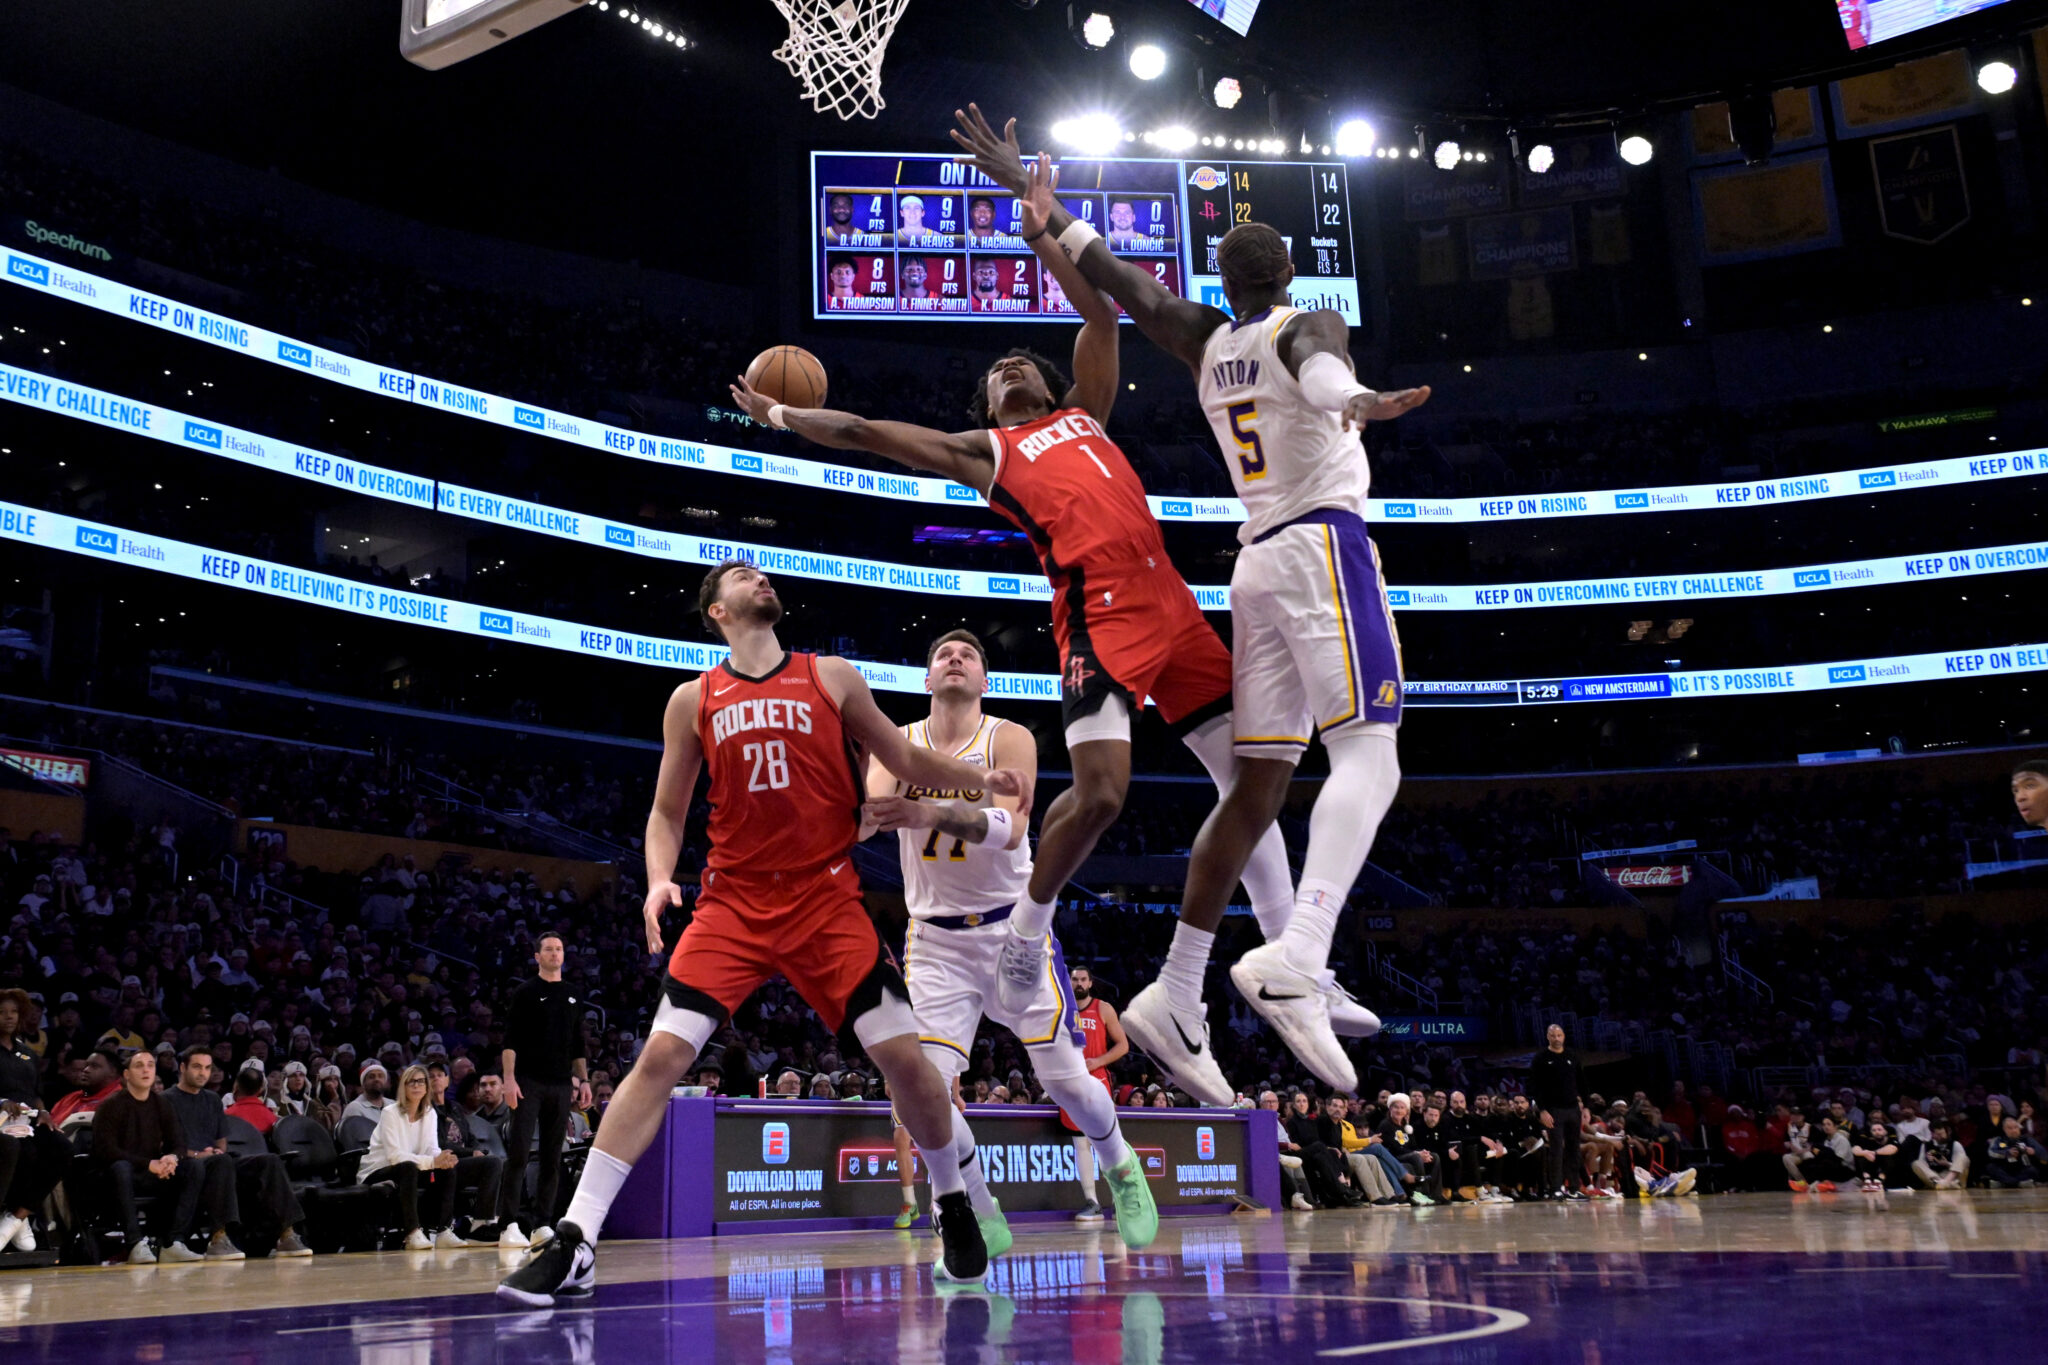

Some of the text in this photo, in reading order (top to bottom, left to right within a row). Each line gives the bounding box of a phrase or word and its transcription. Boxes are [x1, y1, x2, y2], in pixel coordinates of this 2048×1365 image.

[939, 162, 965, 185] ON
[1235, 172, 1249, 192] 14
[1321, 173, 1338, 193] 14
[870, 197, 882, 216] 4
[941, 197, 953, 219] 9
[1081, 200, 1092, 221] 0
[1151, 201, 1162, 222] 0
[1235, 203, 1252, 223] 22
[1323, 204, 1341, 225] 22
[869, 219, 885, 230] PTS
[940, 220, 956, 232] PTS
[1150, 224, 1165, 235] PTS
[25, 220, 108, 261] Spectrum
[840, 234, 882, 247] D. AYTON
[910, 236, 955, 248] A. REAVES
[970, 237, 979, 249] R.
[1121, 239, 1129, 251] L.
[1311, 237, 1338, 247] Rockets
[1317, 249, 1329, 261] TOL
[1333, 250, 1338, 261] 7
[872, 258, 884, 279] 8
[943, 259, 955, 280] 0
[1014, 260, 1026, 282] 2
[1155, 263, 1166, 283] 2
[1317, 262, 1331, 274] FLS
[1335, 263, 1340, 274] 2
[12, 260, 97, 298] UCLA Health
[870, 282, 887, 293] PTS
[941, 283, 958, 294] PTS
[1013, 284, 1029, 295] PTS
[830, 297, 895, 310] A. THOMPSON
[901, 298, 967, 311] D. FINNEY-SMITH
[981, 299, 1030, 312] K. DURANT
[129, 294, 249, 348] KEEP ON RISING
[282, 346, 351, 377] UCLA Health
[1213, 360, 1259, 392] AYTON
[379, 372, 488, 415] KEEP ON RISING
[56, 387, 151, 430] CHALLENGE
[518, 412, 580, 436] UCLA Health
[189, 427, 265, 458] UCLA Health
[605, 430, 705, 464] KEEP ON RISING
[1226, 399, 1267, 482] 5
[735, 457, 798, 477] UCLA Health
[1079, 444, 1112, 478] 1
[1969, 458, 2008, 477] KEEP
[2012, 455, 2034, 471] ON
[824, 469, 919, 496] KEEP ON RISING
[1863, 469, 1939, 485] UCLA Health
[295, 452, 580, 535] KEEP ON OVERCOMING EVERY CHALLENGE
[949, 488, 973, 498] UCLA
[1619, 493, 1688, 506] UCLA Health
[1716, 478, 1830, 504] KEEP ON RISING
[1166, 504, 1230, 515] UCLA Health
[1388, 506, 1453, 516] UCLA Health
[1480, 496, 1587, 517] KEEP ON RISING
[81, 532, 165, 561] UCLA Health
[609, 529, 671, 551] UCLA Health
[699, 543, 960, 590] KEEP ON OVERCOMING EVERY CHALLENGE
[1799, 568, 1874, 584] UCLA Health
[1905, 558, 1943, 577] KEEP
[1949, 556, 1971, 572] ON
[202, 554, 448, 623] KEEP ON BELIEVING IT'S POSSIBLE
[992, 580, 1016, 591] UCLA
[1475, 576, 1765, 605] KEEP ON OVERCOMING EVERY CHALLENGE
[1412, 593, 1448, 604] Health
[484, 617, 551, 638] UCLA Health
[580, 631, 704, 666] KEEP ON BELIEVING
[1833, 664, 1910, 680] UCLA Health
[1945, 655, 1985, 673] KEEP
[1990, 652, 2012, 669] ON
[864, 670, 897, 683] Health
[1693, 675, 1720, 691] IT'S
[1724, 671, 1795, 690] POSSIBLE
[1402, 682, 1508, 692] PPY BIRTHDAY MARIO
[1526, 685, 1559, 698] 5:29
[1585, 683, 1604, 696] NEW
[1605, 681, 1658, 695] AMSTERDAM
[712, 699, 812, 746] ROCKETS
[743, 740, 790, 792] 28
[1618, 866, 1672, 886] Coca-Cola
[1422, 1023, 1465, 1034] ULTRA
[1008, 1145, 1028, 1182] IN
[1177, 1165, 1236, 1182] DOWNLOAD NOW
[727, 1170, 823, 1193] DOWNLOAD NOW
[730, 1198, 821, 1210] All of ESPN. All in one place.
